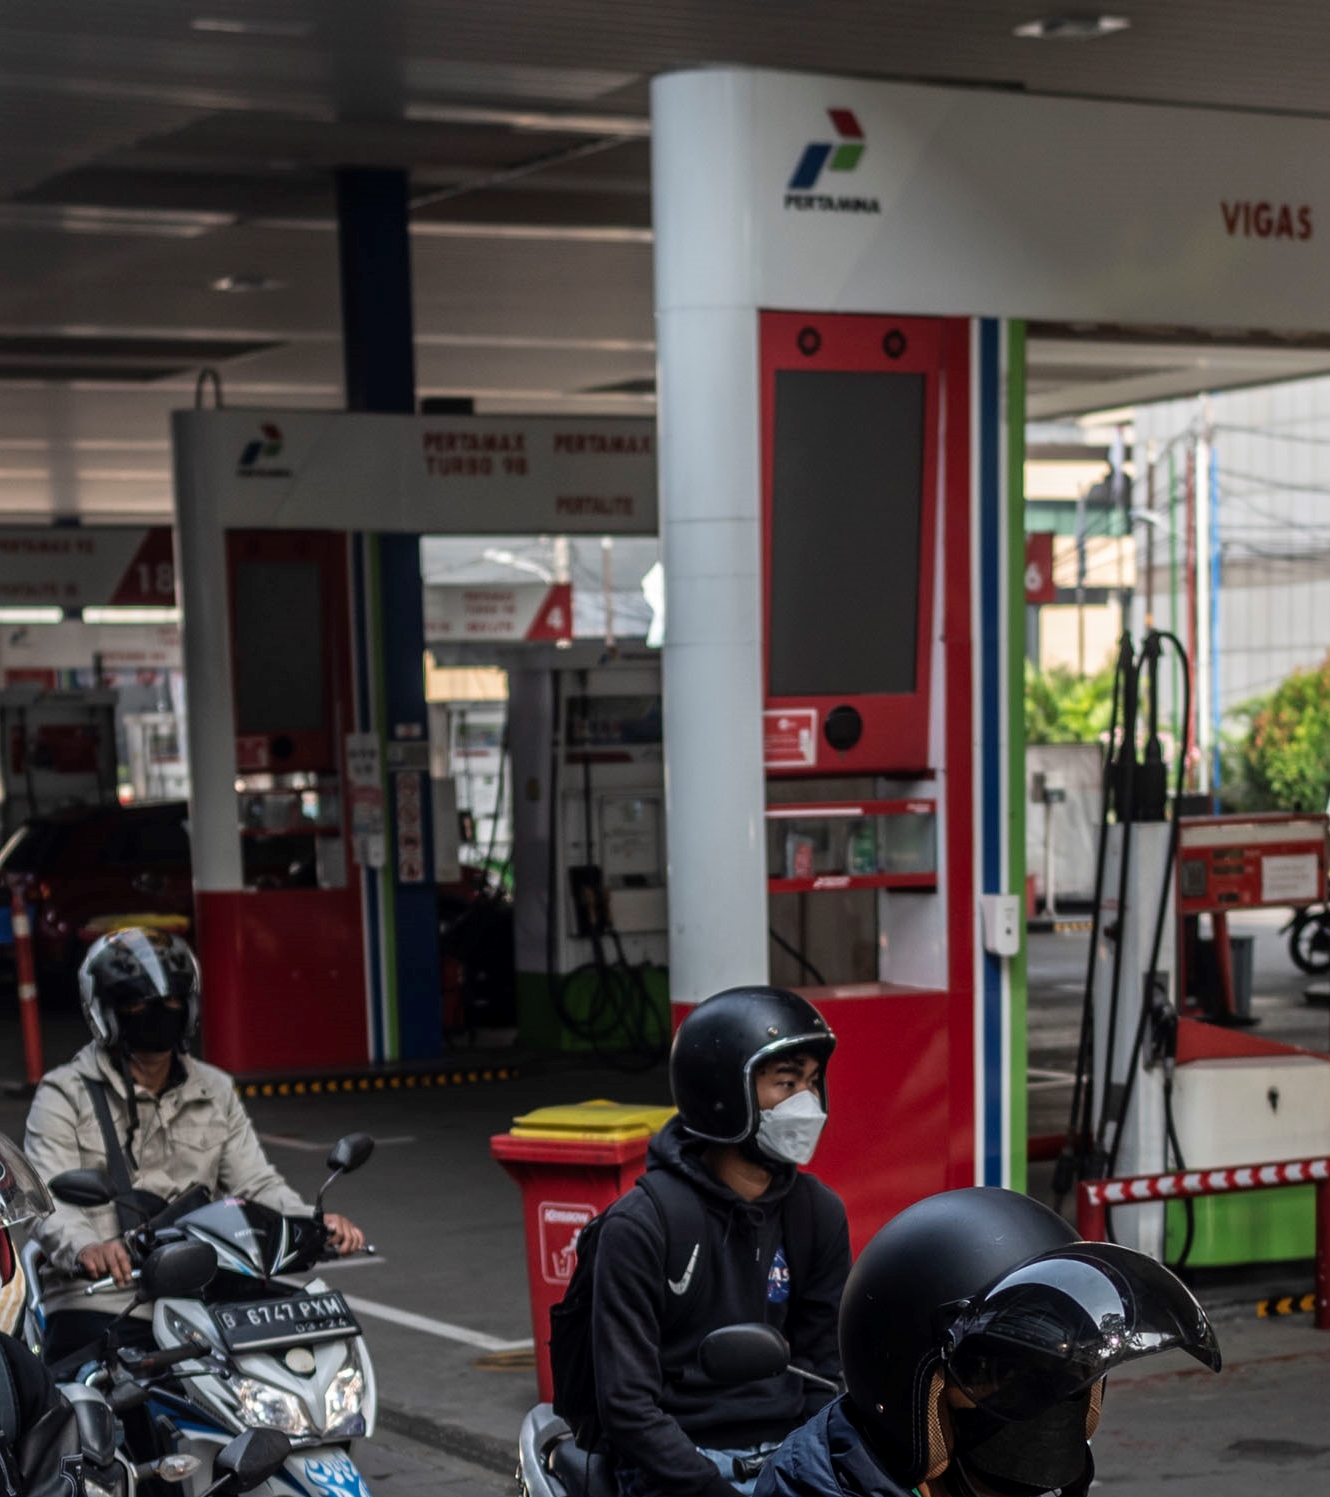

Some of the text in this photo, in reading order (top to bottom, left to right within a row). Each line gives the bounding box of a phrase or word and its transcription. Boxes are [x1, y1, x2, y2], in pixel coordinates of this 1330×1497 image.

[784, 194, 881, 215] PERTAMINA
[1220, 200, 1313, 242] VIGAS
[137, 563, 174, 595] 18
[545, 606, 563, 630] 4
[222, 1297, 340, 1329] B 6747 PXM
